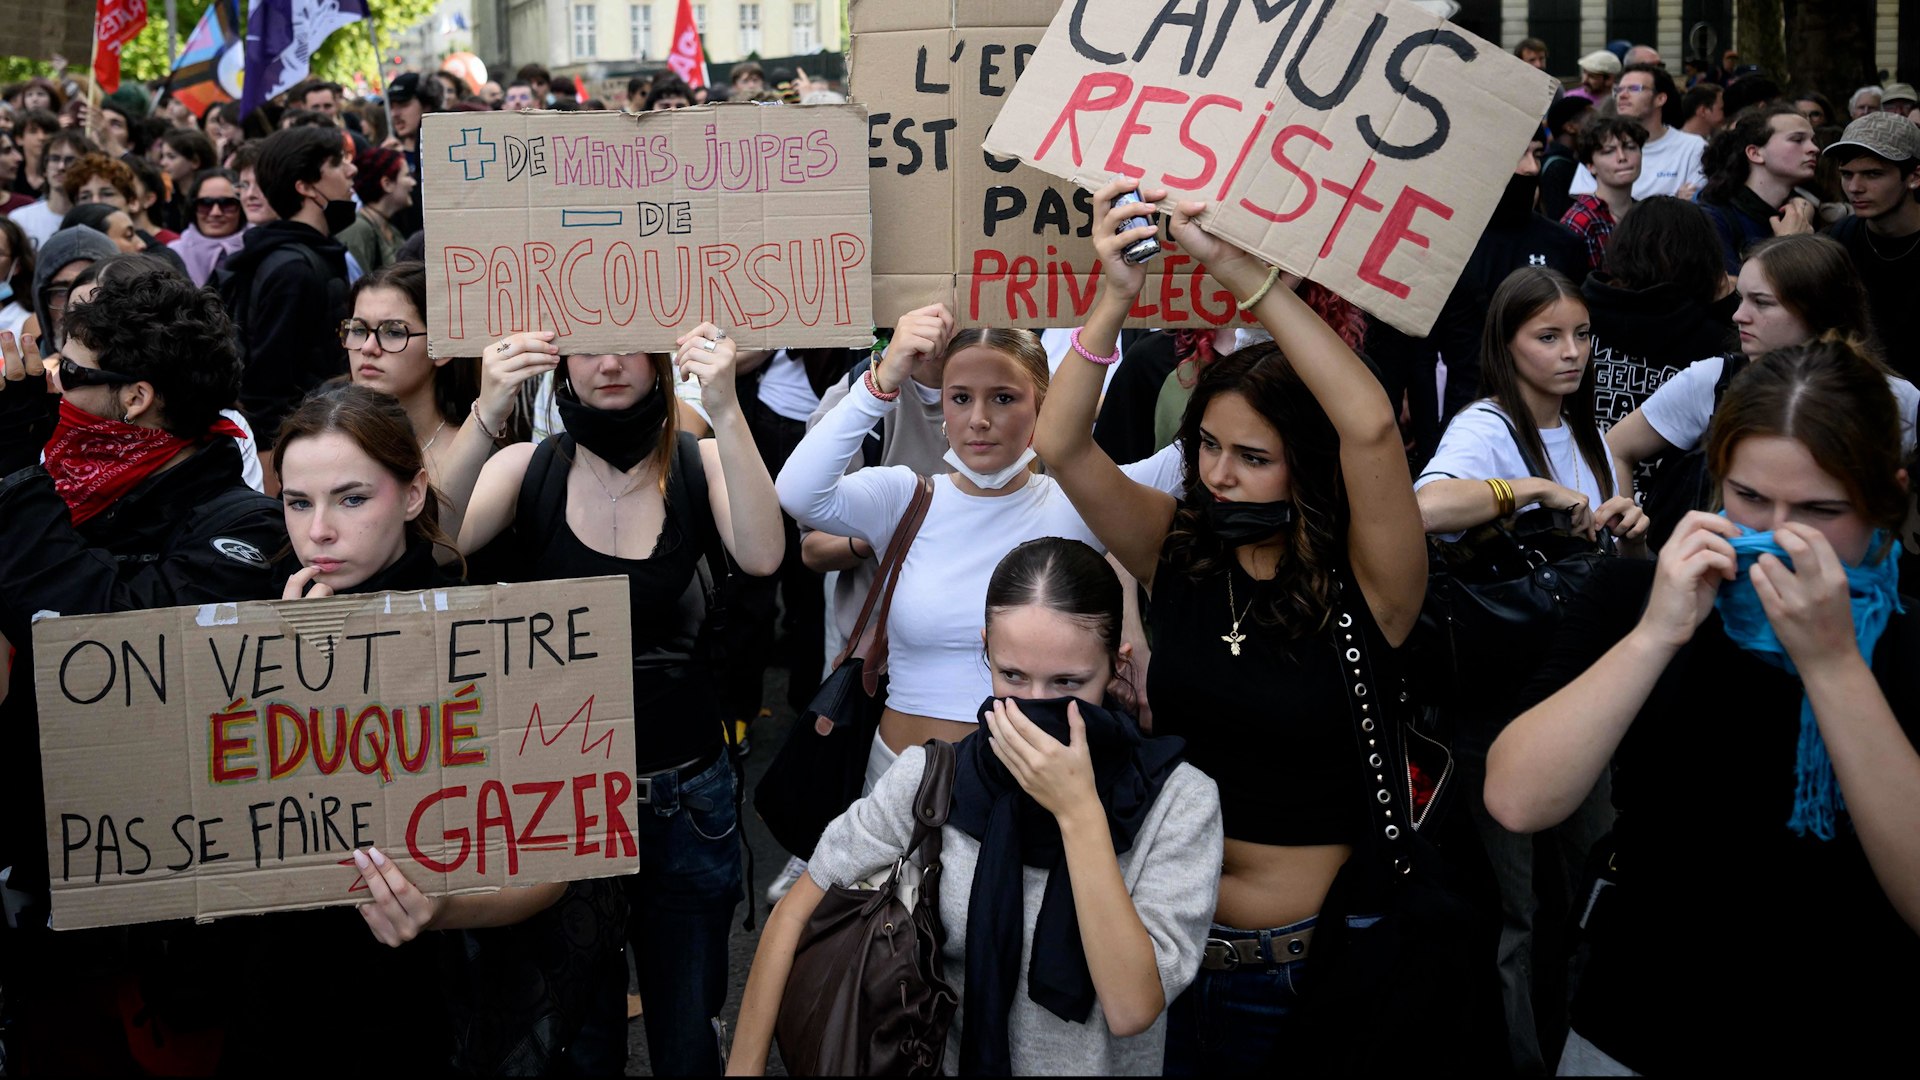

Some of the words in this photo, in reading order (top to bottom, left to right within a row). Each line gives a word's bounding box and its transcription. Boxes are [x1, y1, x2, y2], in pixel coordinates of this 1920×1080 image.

[1069, 0, 1479, 161] CAMUS
[504, 135, 546, 182] DE
[869, 112, 957, 175] EST
[638, 201, 692, 237] DE
[983, 186, 1094, 238] PAS
[444, 232, 866, 340] PARCOURSUP
[58, 633, 167, 707] ON
[209, 630, 401, 701] VEUT
[448, 606, 599, 683] ETRE
[207, 682, 491, 787] ÉDUQUÉ
[61, 812, 152, 882] PAS
[166, 813, 230, 872] SE
[405, 770, 639, 876] GAZER
